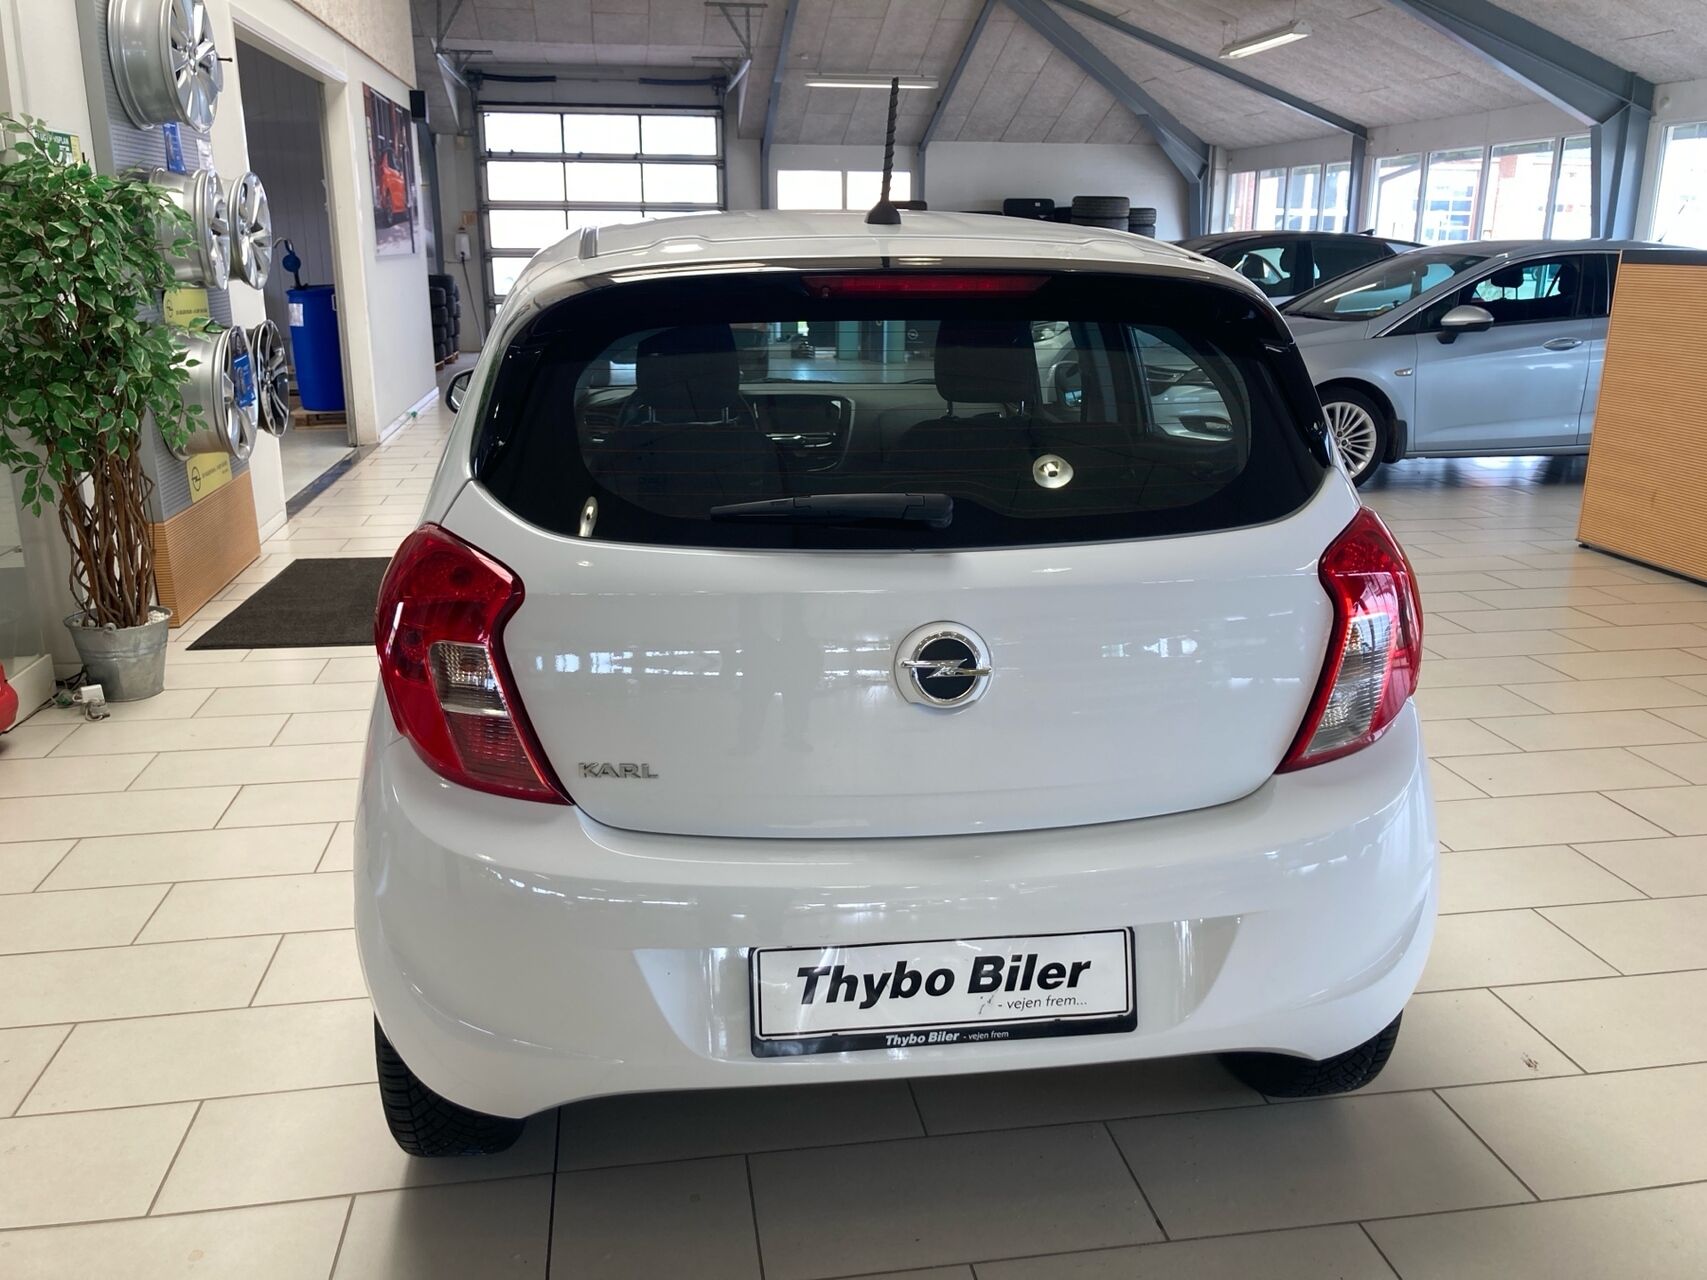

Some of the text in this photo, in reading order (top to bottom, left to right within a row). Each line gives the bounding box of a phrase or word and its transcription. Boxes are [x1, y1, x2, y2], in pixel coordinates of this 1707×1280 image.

[578, 762, 659, 779] KARL
[797, 953, 1092, 1010] Thybo Biler
[1006, 998, 1041, 1012] vejen
[886, 1033, 926, 1047] Thybo
[928, 1030, 960, 1043] Biler
[968, 1032, 989, 1041] vejen
[990, 1030, 1009, 1039] frem
